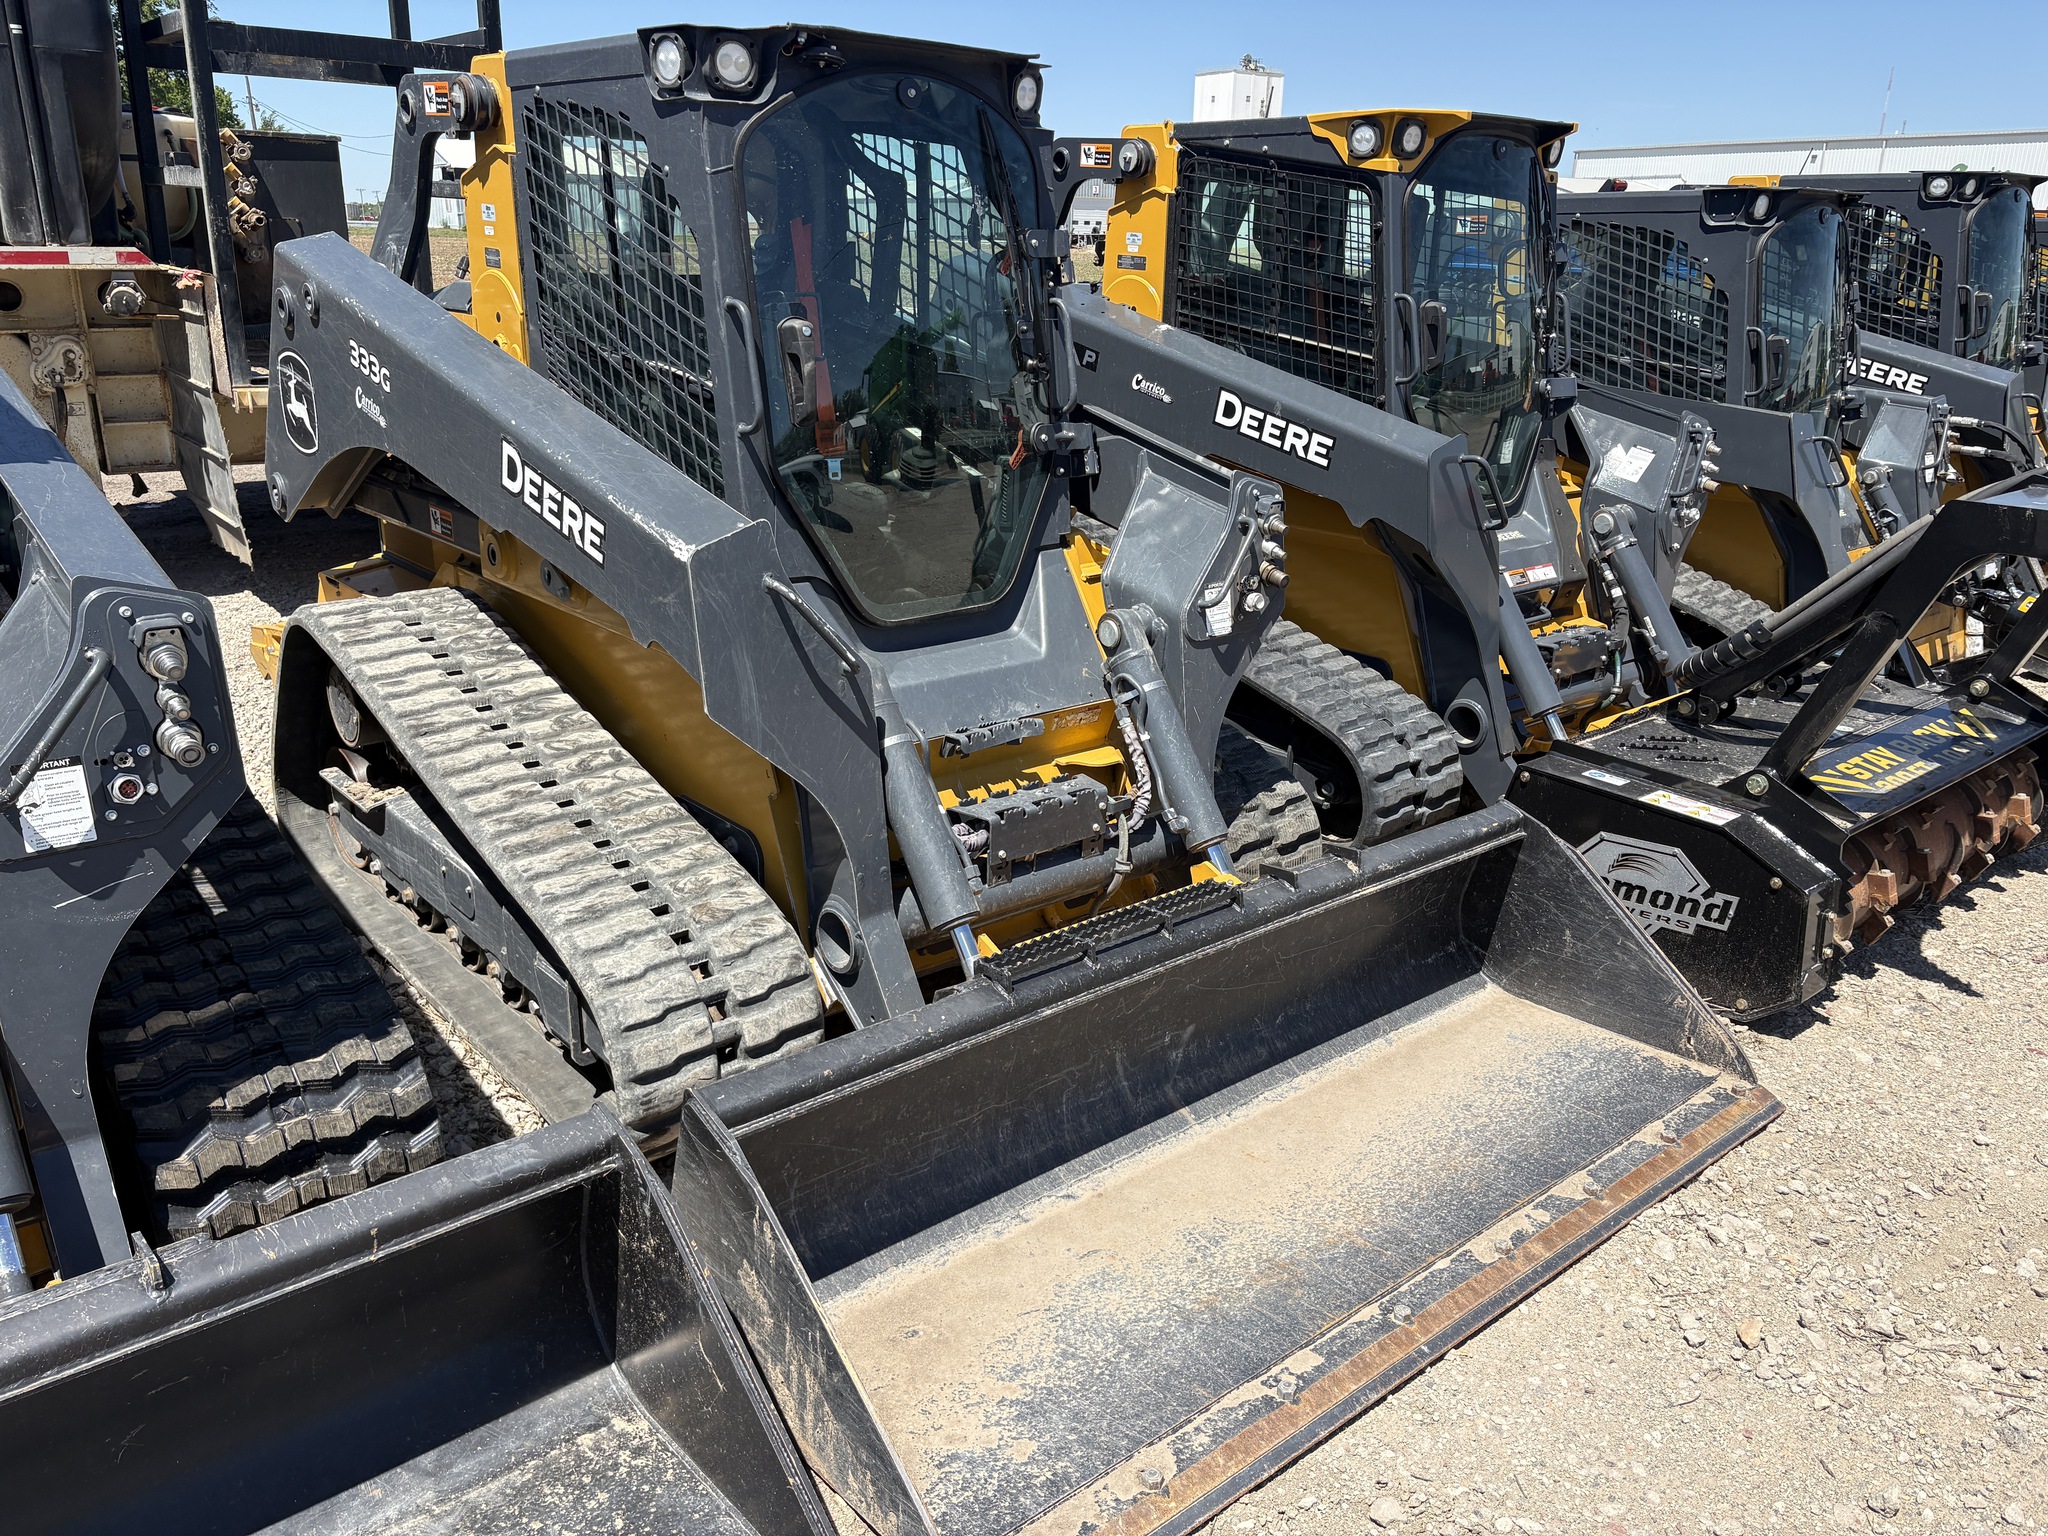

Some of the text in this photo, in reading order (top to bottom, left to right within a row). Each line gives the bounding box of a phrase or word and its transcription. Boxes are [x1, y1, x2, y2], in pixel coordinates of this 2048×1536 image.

[349, 339, 391, 393] 333G
[1131, 373, 1165, 396] Carrico
[1842, 357, 1929, 396] EERE
[1214, 390, 1334, 468] DEERE
[501, 439, 605, 565] DEERE
[1835, 719, 1962, 780] STAY BACK
[1601, 875, 1734, 926] mond
